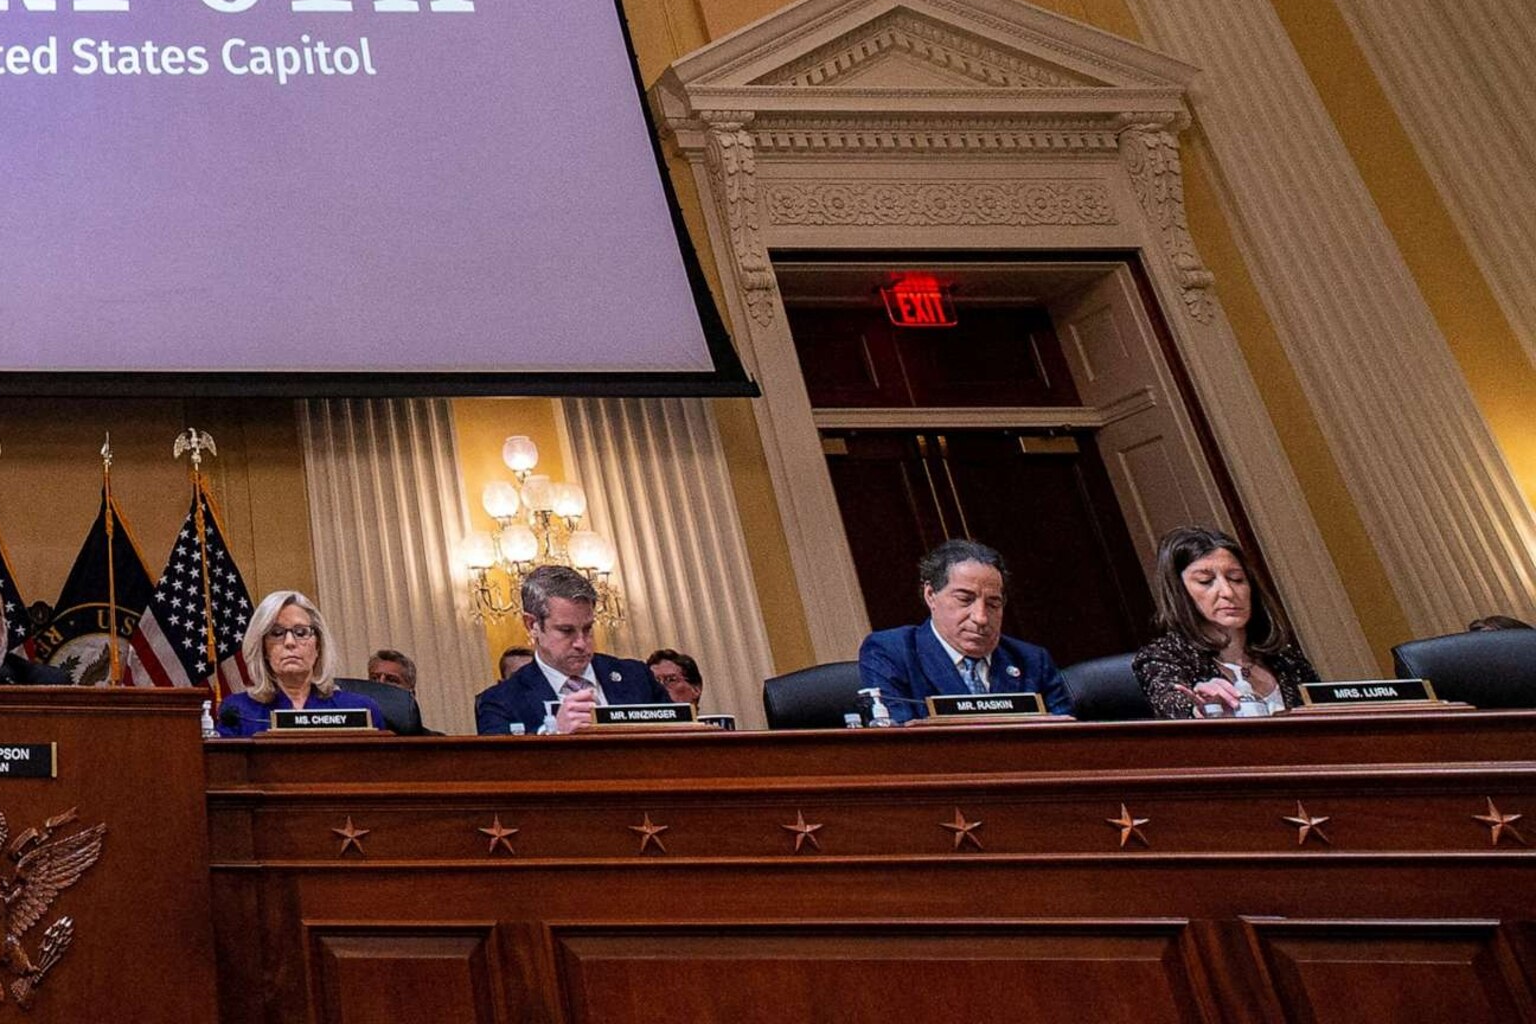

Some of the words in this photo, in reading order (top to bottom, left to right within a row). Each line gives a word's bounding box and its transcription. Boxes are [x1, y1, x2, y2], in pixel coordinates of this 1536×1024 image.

[72, 37, 209, 75] States
[222, 34, 376, 85] Capitol
[896, 292, 946, 323] EXIT
[1333, 688, 1364, 699] MRS.
[1364, 686, 1398, 698] LURIA
[956, 701, 976, 711] MR.
[976, 699, 1013, 711] RASKIN
[295, 715, 310, 725] MS.
[311, 715, 347, 725] CHENEY
[609, 710, 627, 721] MR.
[627, 708, 677, 721] KINZINGER
